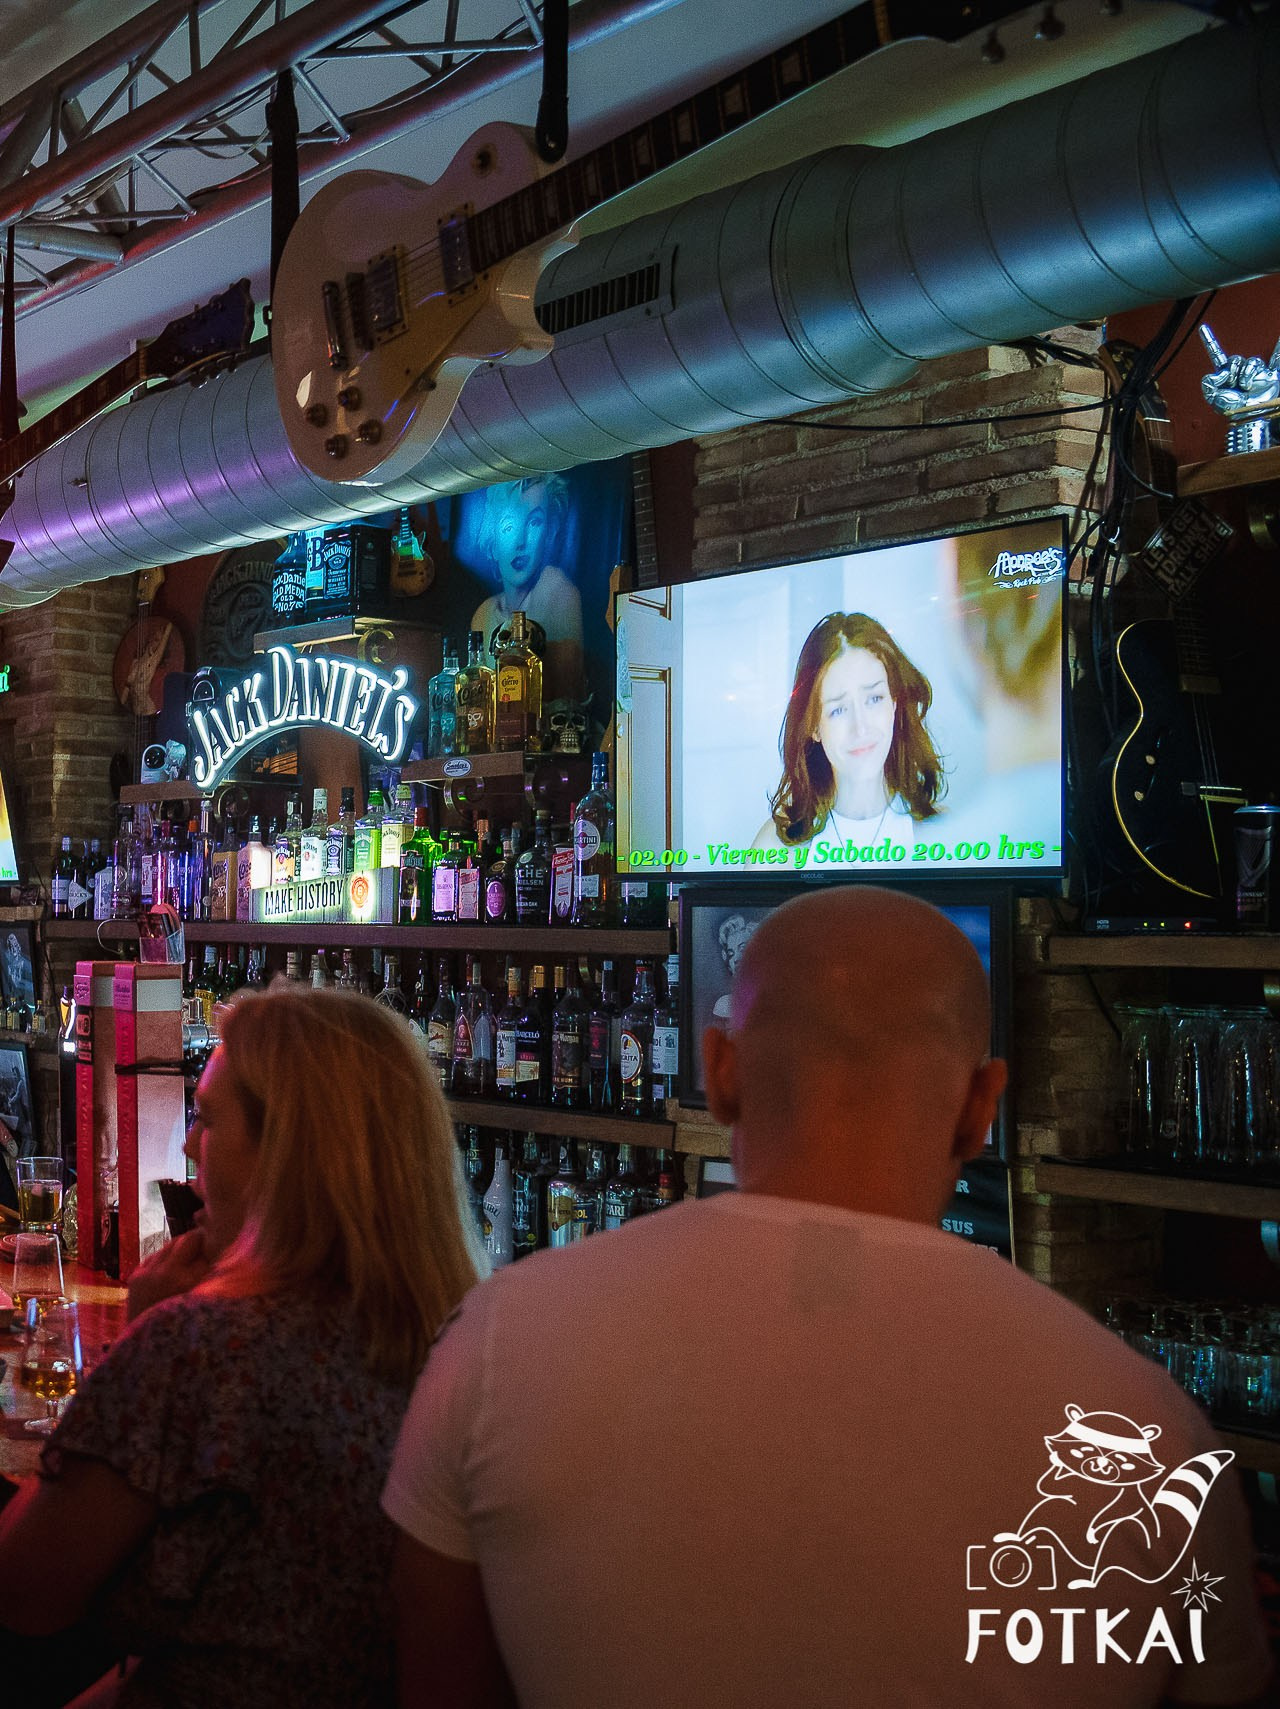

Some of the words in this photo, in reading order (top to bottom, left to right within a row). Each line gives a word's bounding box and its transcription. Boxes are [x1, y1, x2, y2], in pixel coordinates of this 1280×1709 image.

[283, 572, 306, 587] Danie
[284, 584, 305, 601] MEDA
[193, 673, 269, 788] JACK
[267, 646, 417, 761] DANIEL'S
[629, 850, 688, 867] 02.00
[707, 844, 789, 866] Viernes
[794, 848, 809, 869] y
[814, 838, 905, 864] Sabado
[912, 841, 990, 861] 20.00
[997, 834, 1045, 860] hrs
[264, 888, 293, 916] MAKE
[297, 879, 343, 910] HISTORY
[485, 1202, 501, 1217] LIBU
